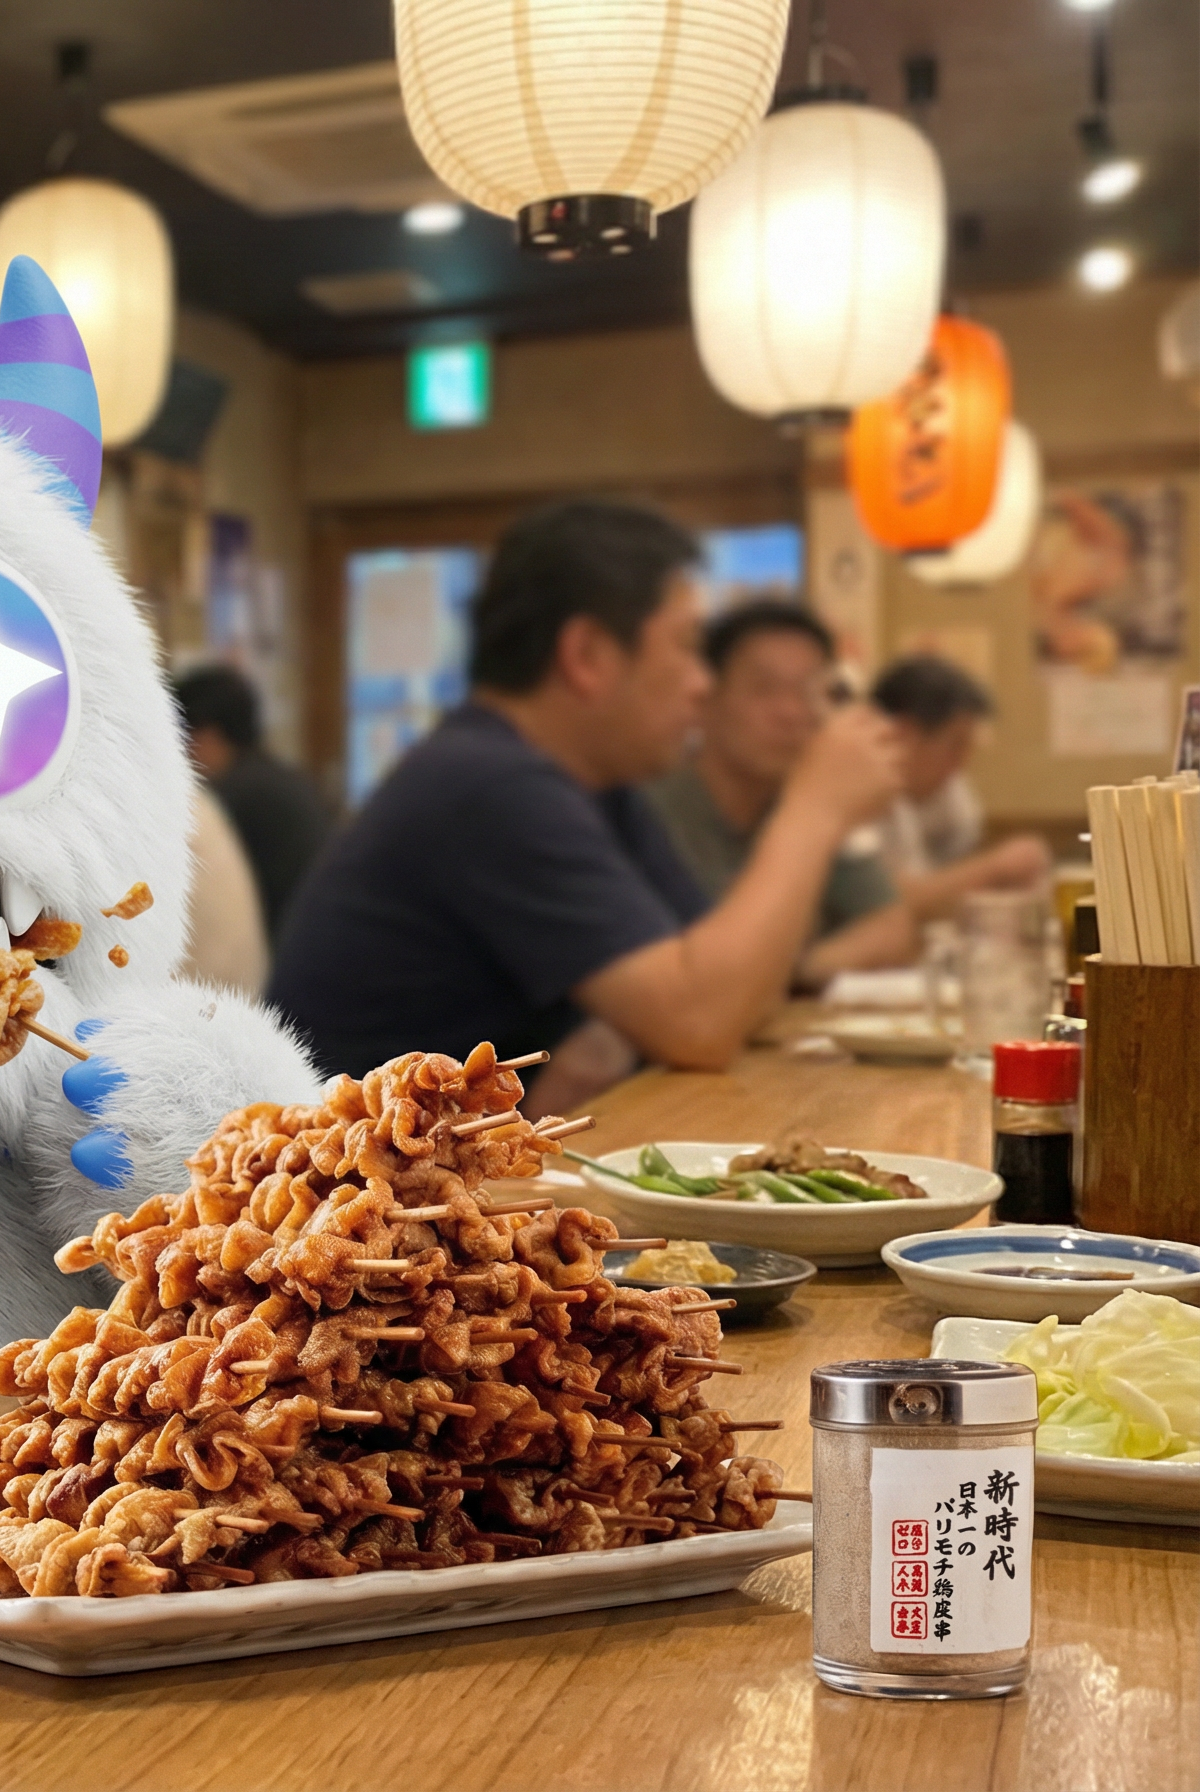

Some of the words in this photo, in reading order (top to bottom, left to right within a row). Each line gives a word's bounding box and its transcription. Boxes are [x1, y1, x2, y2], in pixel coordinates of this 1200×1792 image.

[957, 1482, 977, 1555] 日本一の
[983, 1470, 1019, 1580] 新時代
